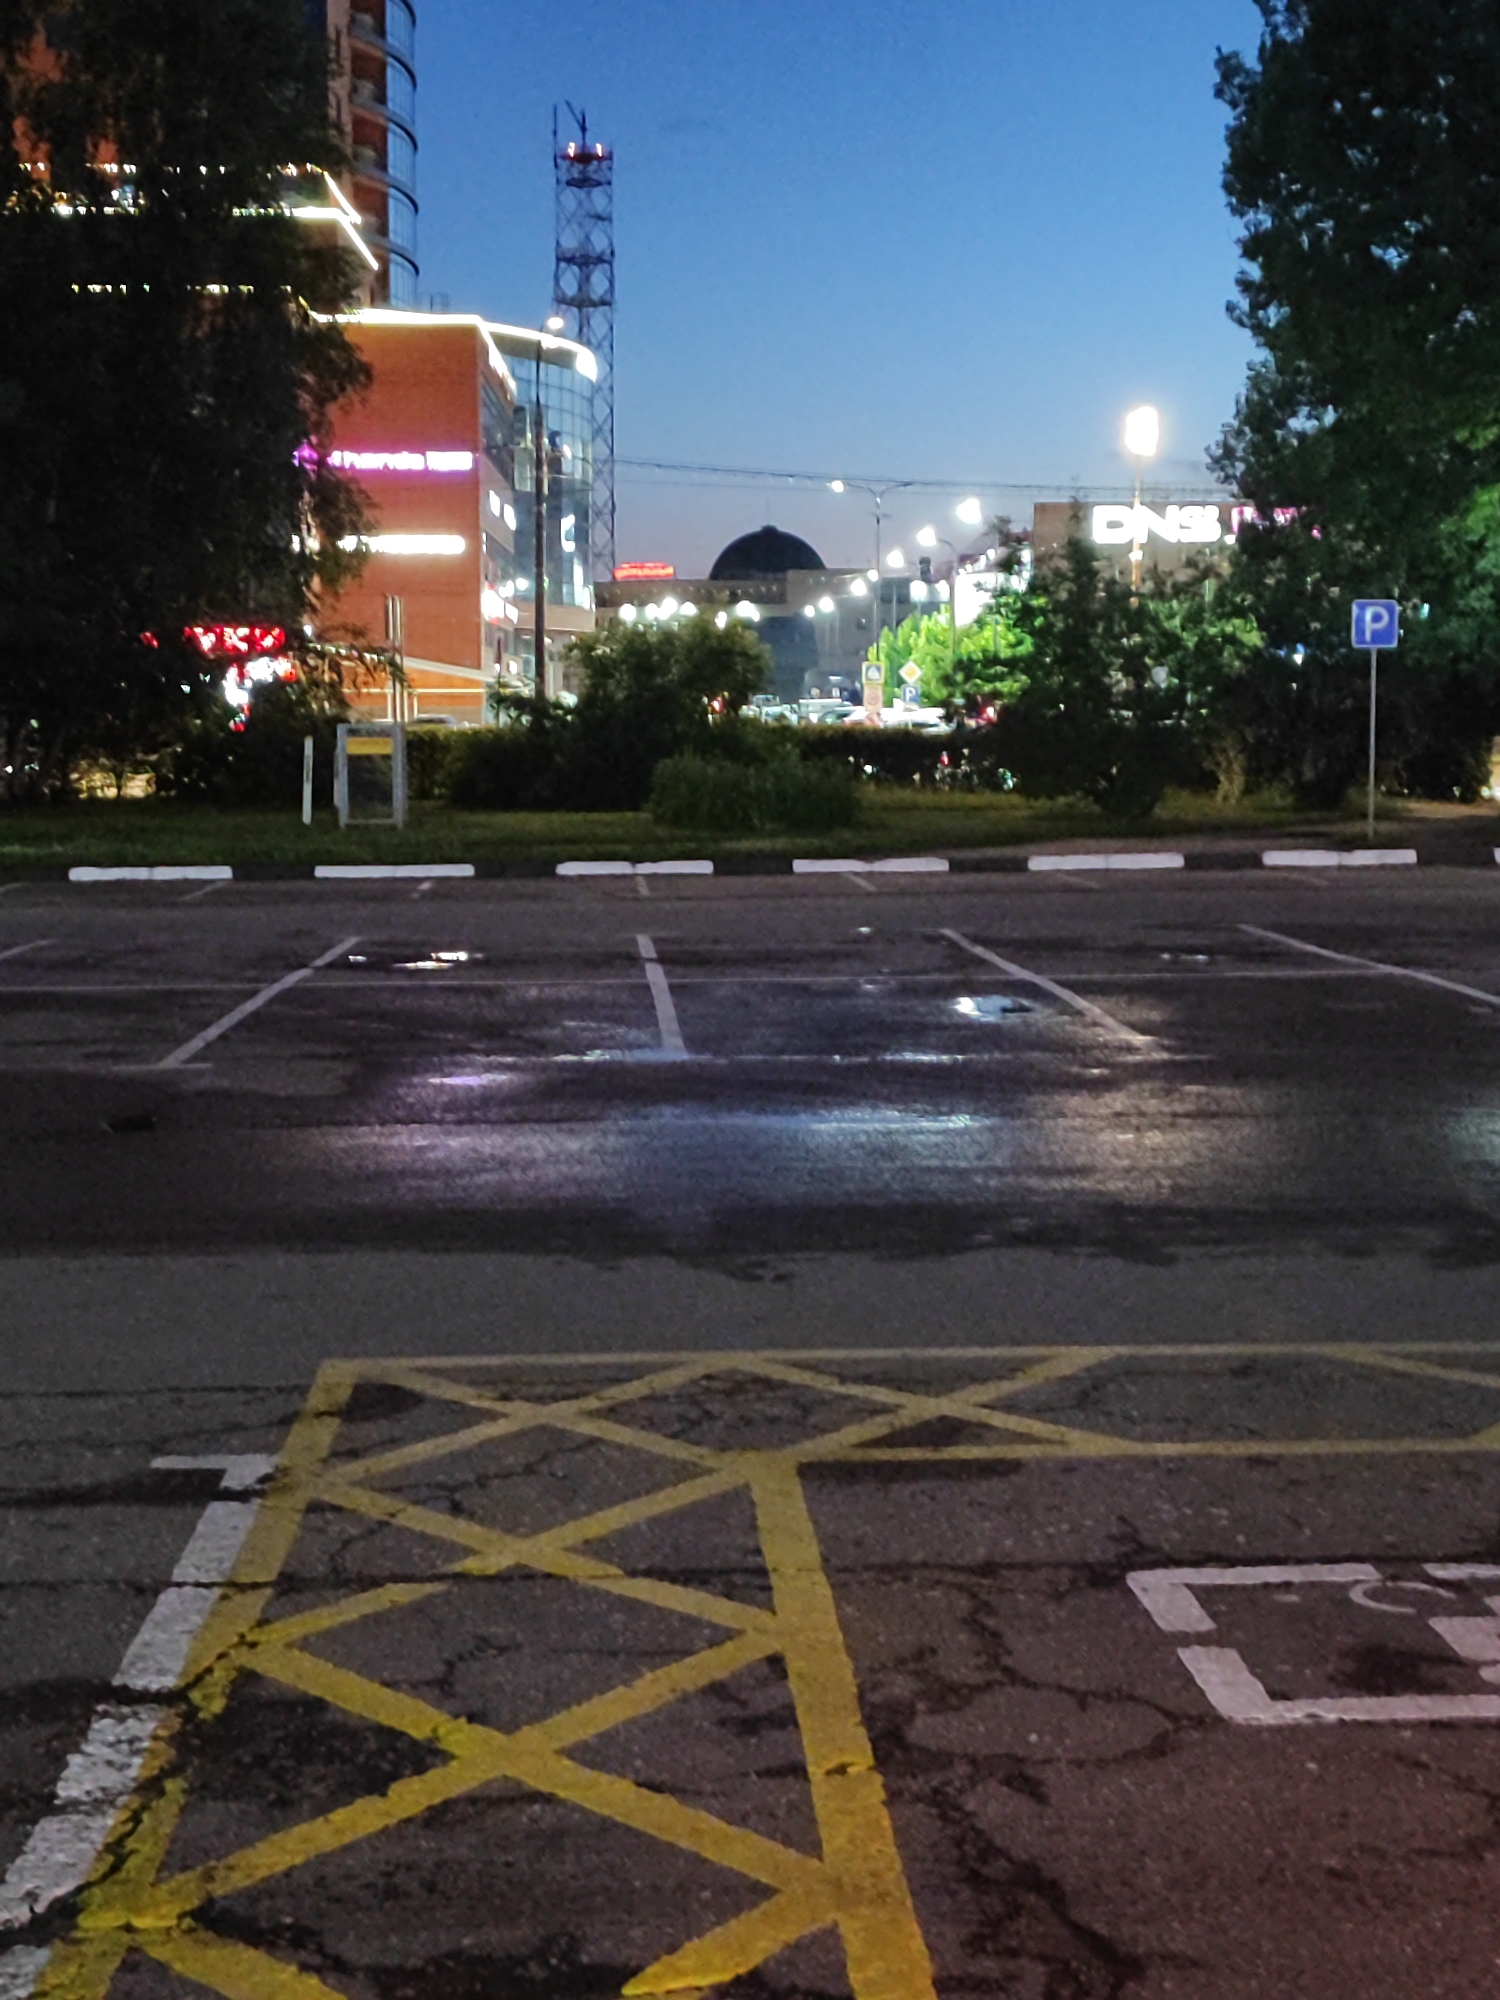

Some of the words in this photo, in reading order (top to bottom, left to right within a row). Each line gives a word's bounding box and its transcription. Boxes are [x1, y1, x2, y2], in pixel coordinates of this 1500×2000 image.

[1092, 504, 1222, 544] DNS
[1365, 605, 1389, 642] P
[905, 686, 917, 703] P
